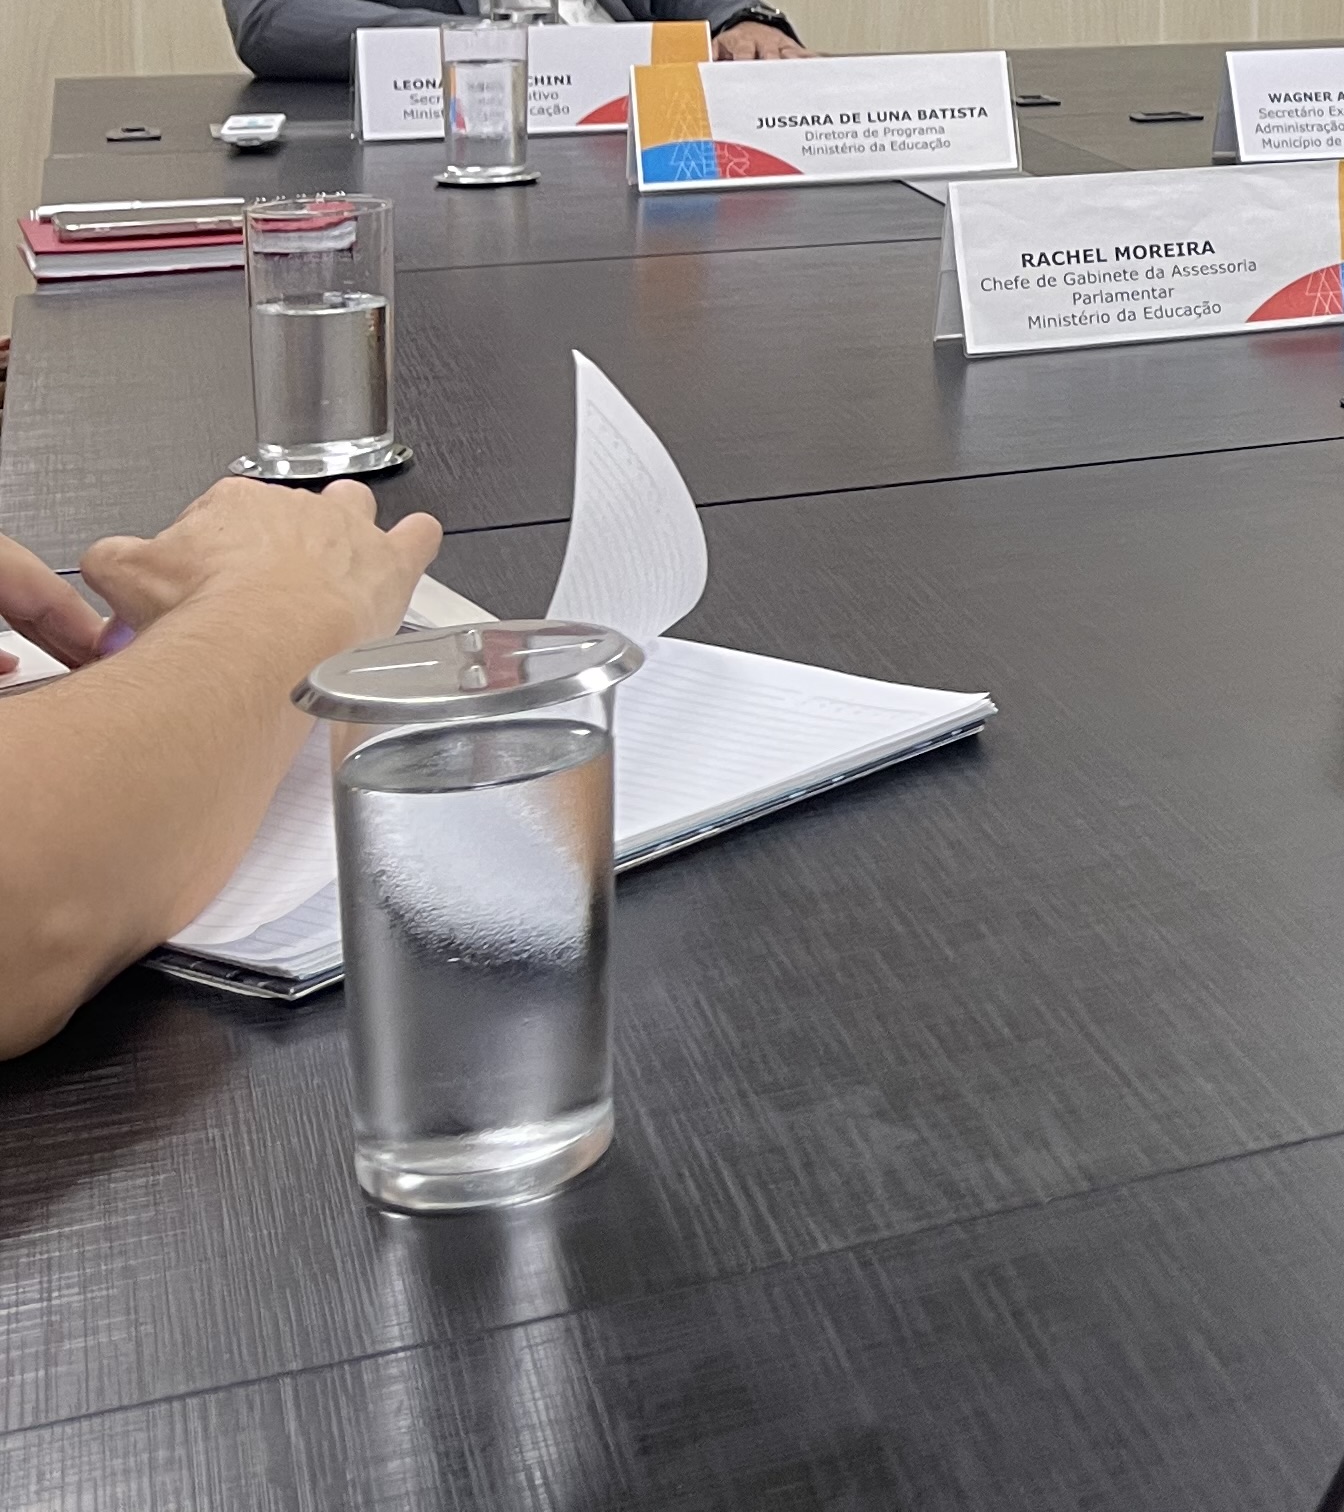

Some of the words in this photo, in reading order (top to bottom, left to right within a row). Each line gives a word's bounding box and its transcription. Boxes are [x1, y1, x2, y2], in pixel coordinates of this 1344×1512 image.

[1268, 92, 1332, 103] WAGNER
[757, 114, 833, 128] JUSSARA
[840, 113, 861, 124] DE
[868, 110, 911, 123] LUNA
[918, 107, 988, 121] BATISTA
[1259, 107, 1324, 119] Secretário
[805, 129, 857, 141] Diretora
[863, 127, 878, 138] de
[884, 125, 945, 139] Programa
[1255, 120, 1344, 135] Administração
[802, 141, 865, 156] Ministério
[870, 141, 886, 152] da
[891, 137, 951, 152] Educação
[1262, 136, 1322, 150] Município
[1327, 136, 1341, 146] de
[1021, 248, 1107, 268] RACHEL
[1115, 240, 1216, 262] MOREIRA
[981, 274, 1031, 292] Chefe
[1036, 273, 1056, 288] de
[1063, 268, 1139, 287] Gabinete
[1145, 266, 1165, 281] da
[1171, 260, 1256, 279] Assessoria
[1072, 287, 1174, 306] Parlamentar
[1028, 311, 1111, 330] Ministério
[1118, 309, 1137, 324] da
[1144, 300, 1221, 321] Educação
